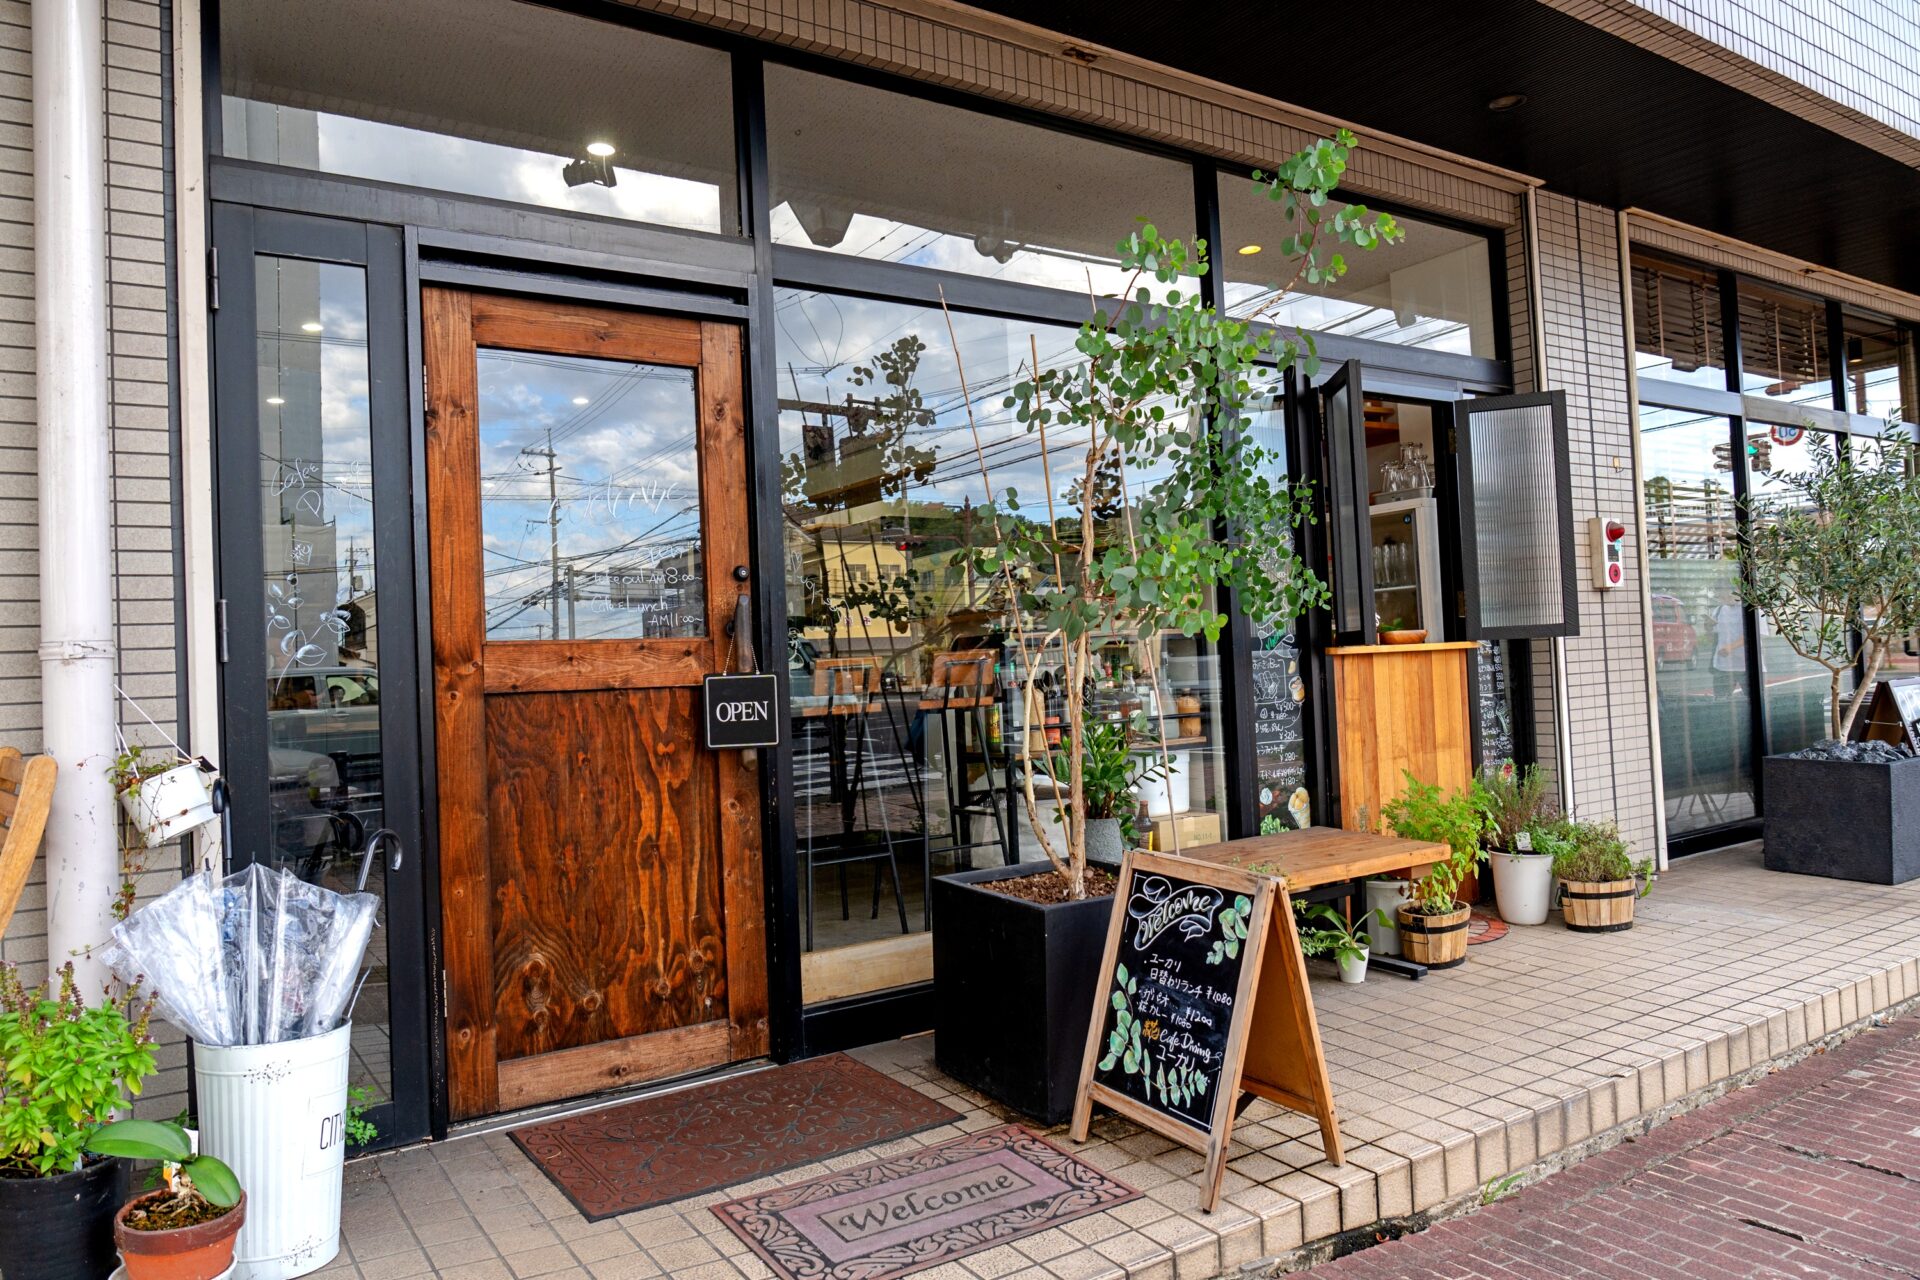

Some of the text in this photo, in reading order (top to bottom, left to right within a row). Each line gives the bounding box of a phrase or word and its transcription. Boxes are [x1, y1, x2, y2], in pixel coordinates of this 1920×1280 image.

[716, 700, 769, 722] OPEN
[1141, 890, 1212, 944] Welcome
[839, 1174, 1015, 1232] Welcome
